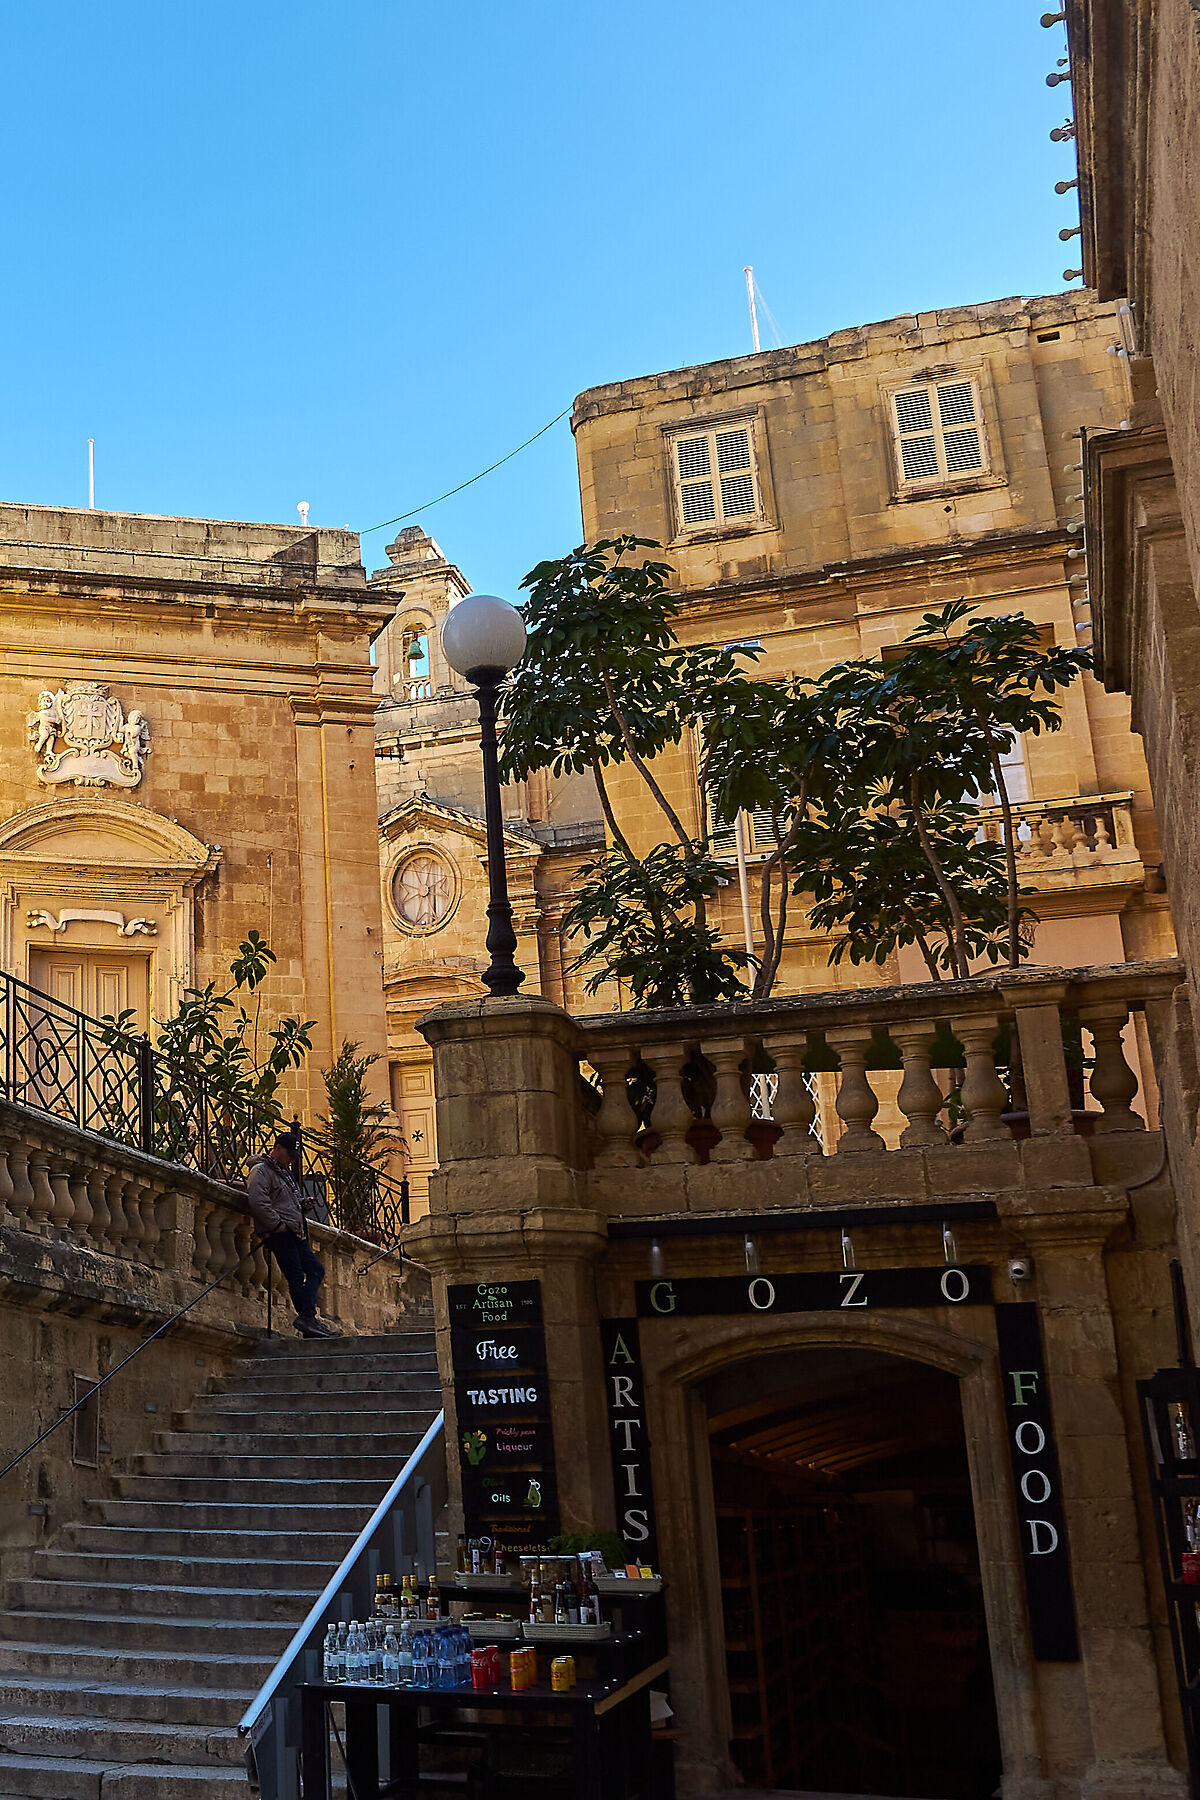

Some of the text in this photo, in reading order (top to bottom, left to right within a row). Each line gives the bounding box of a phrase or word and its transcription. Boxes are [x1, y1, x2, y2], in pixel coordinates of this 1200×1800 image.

[477, 1284, 508, 1295] Gozo
[650, 1269, 969, 1313] GOZO
[472, 1299, 513, 1309] Artisan
[482, 1311, 508, 1322] Food
[476, 1340, 519, 1360] Free
[467, 1387, 538, 1405] TASTING
[496, 1442, 533, 1452] Liqueur
[1008, 1371, 1058, 1555] FOOD
[491, 1493, 511, 1503] Oils
[501, 1544, 547, 1552] heeselets
